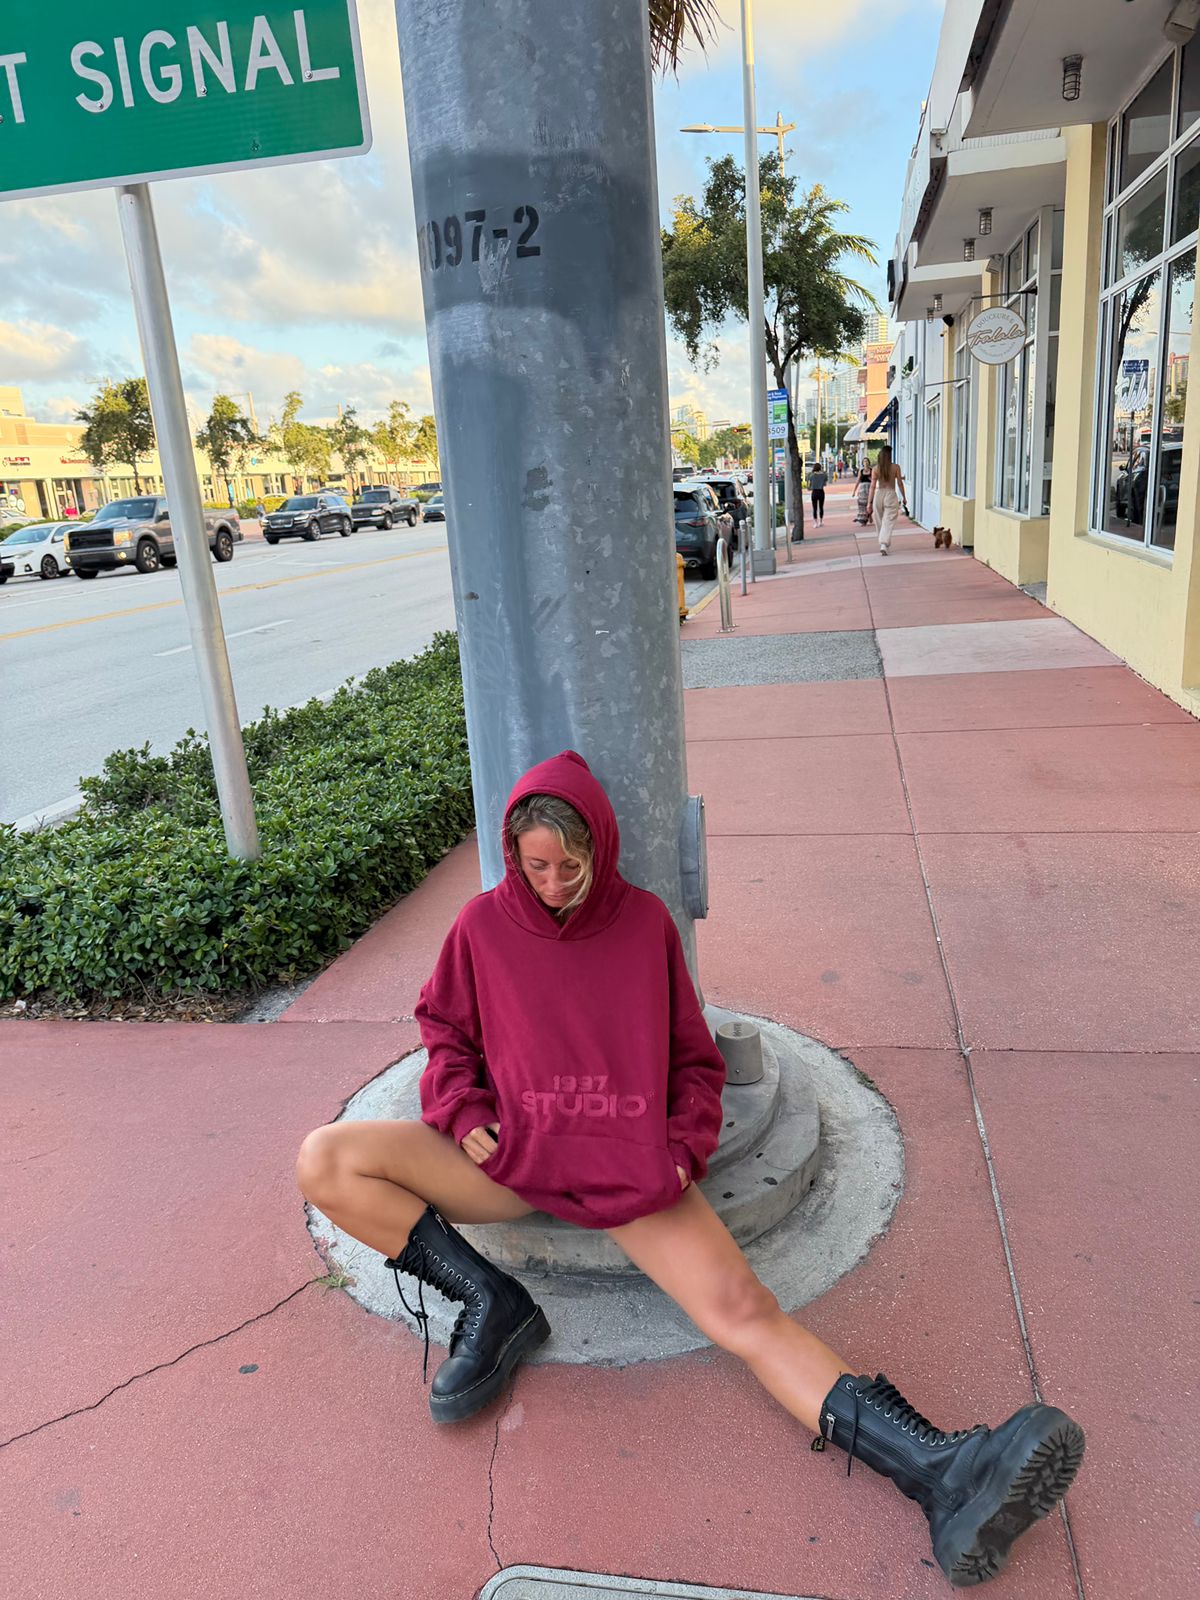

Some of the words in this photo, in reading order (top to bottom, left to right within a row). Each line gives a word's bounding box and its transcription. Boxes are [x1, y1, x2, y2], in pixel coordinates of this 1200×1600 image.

[0, 51, 27, 124] T
[70, 9, 341, 113] SIGNAL
[968, 323, 1026, 349] Tralala
[521, 1090, 647, 1118] STUDIO
